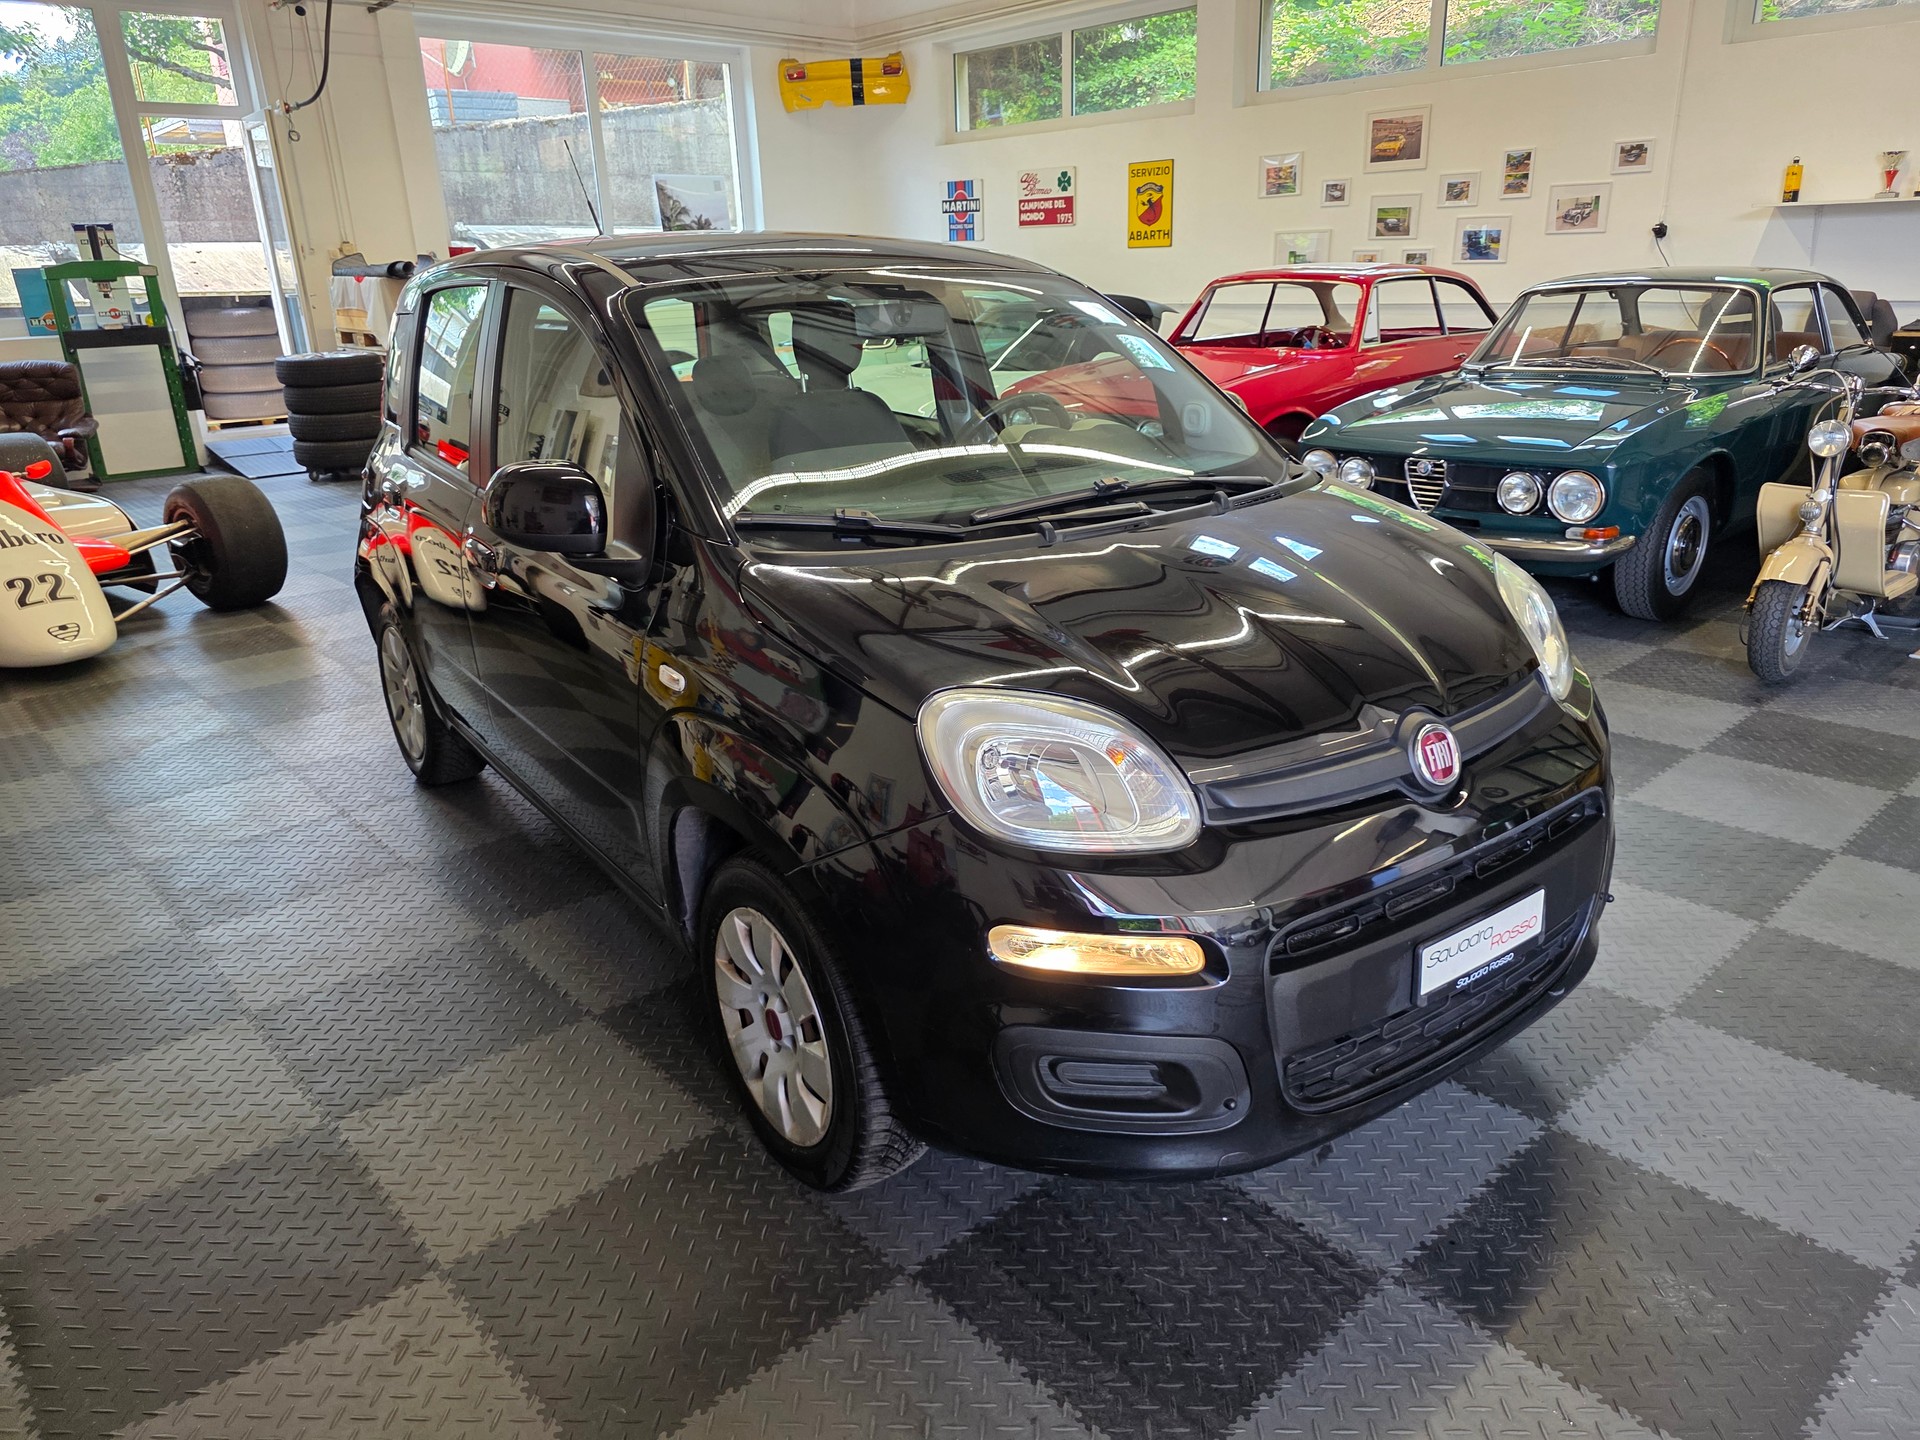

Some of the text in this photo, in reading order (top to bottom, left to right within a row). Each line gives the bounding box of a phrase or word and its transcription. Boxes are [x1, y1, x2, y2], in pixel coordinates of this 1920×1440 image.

[1131, 166, 1170, 178] SERVIZIO
[943, 200, 980, 212] MARTINI
[1021, 200, 1066, 210] CAMPIONE DEL
[1021, 212, 1073, 223] MONDO 1975
[1129, 229, 1170, 240] ABARTH
[4, 573, 77, 610] 22
[1424, 739, 1453, 772] FIAT
